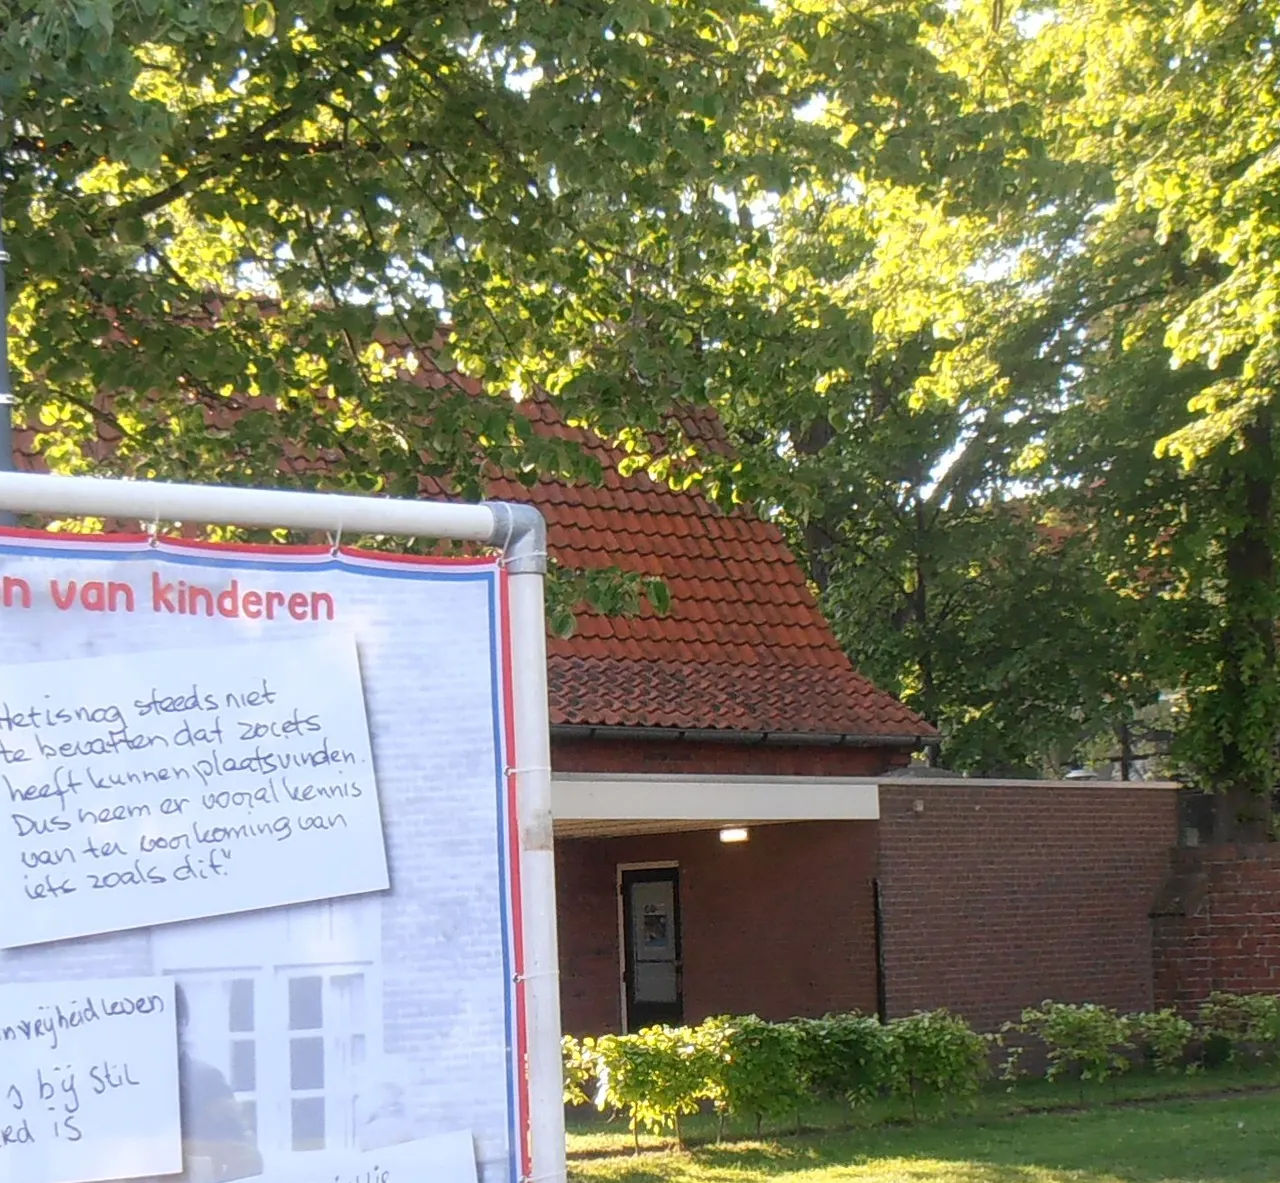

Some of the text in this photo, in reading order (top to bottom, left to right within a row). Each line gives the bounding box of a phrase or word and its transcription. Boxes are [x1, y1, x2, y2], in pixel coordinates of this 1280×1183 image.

[49, 578, 135, 612] van
[151, 572, 335, 621] kinderen
[133, 686, 220, 717] steeds
[225, 678, 278, 708] niet
[172, 714, 223, 748] dat
[1, 764, 83, 812] heeft
[85, 764, 190, 792] kunnen
[10, 812, 73, 837] Dus
[77, 799, 153, 825] neem
[159, 797, 192, 817] er
[281, 770, 363, 803] kennis
[21, 846, 78, 869] van
[297, 812, 349, 832] van
[85, 857, 169, 891] zoals
